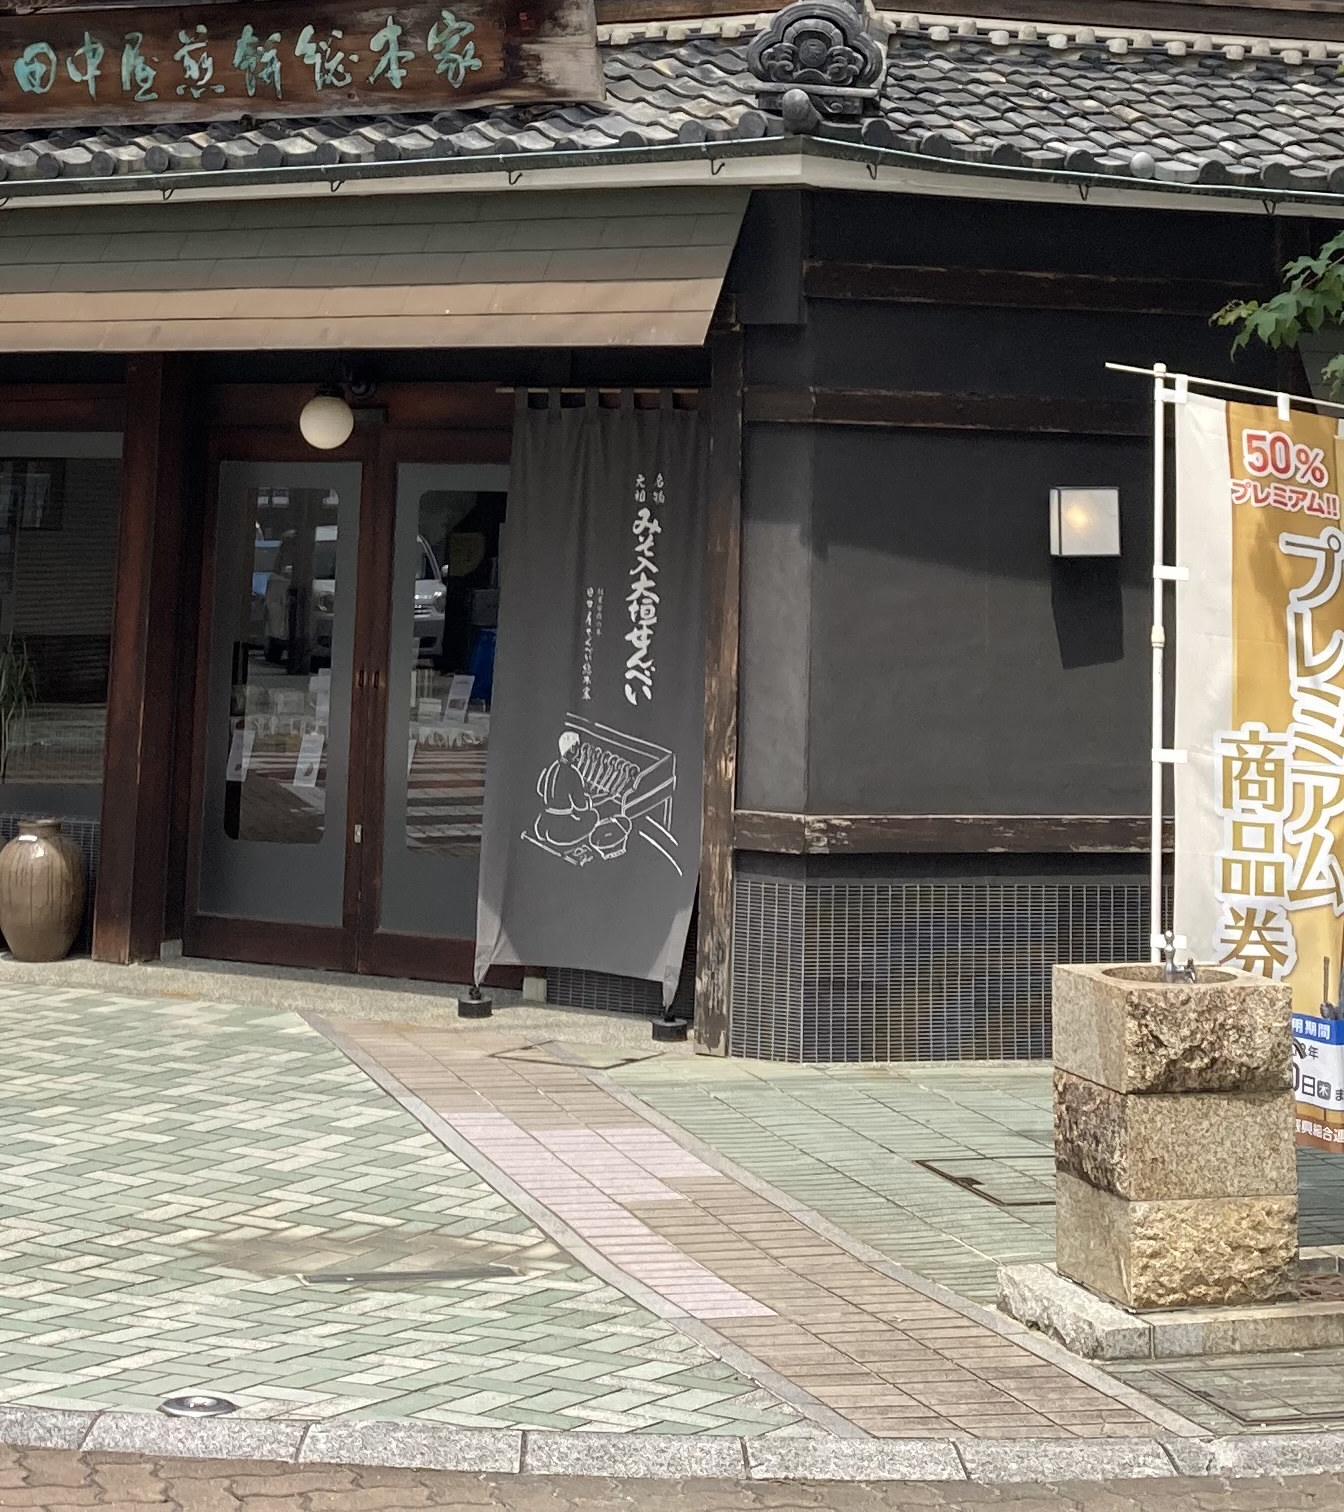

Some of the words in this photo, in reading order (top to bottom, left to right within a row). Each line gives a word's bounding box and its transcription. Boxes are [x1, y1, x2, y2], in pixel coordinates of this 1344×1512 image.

[1244, 431, 1327, 486] 50%
[1219, 730, 1291, 976] 商品券
